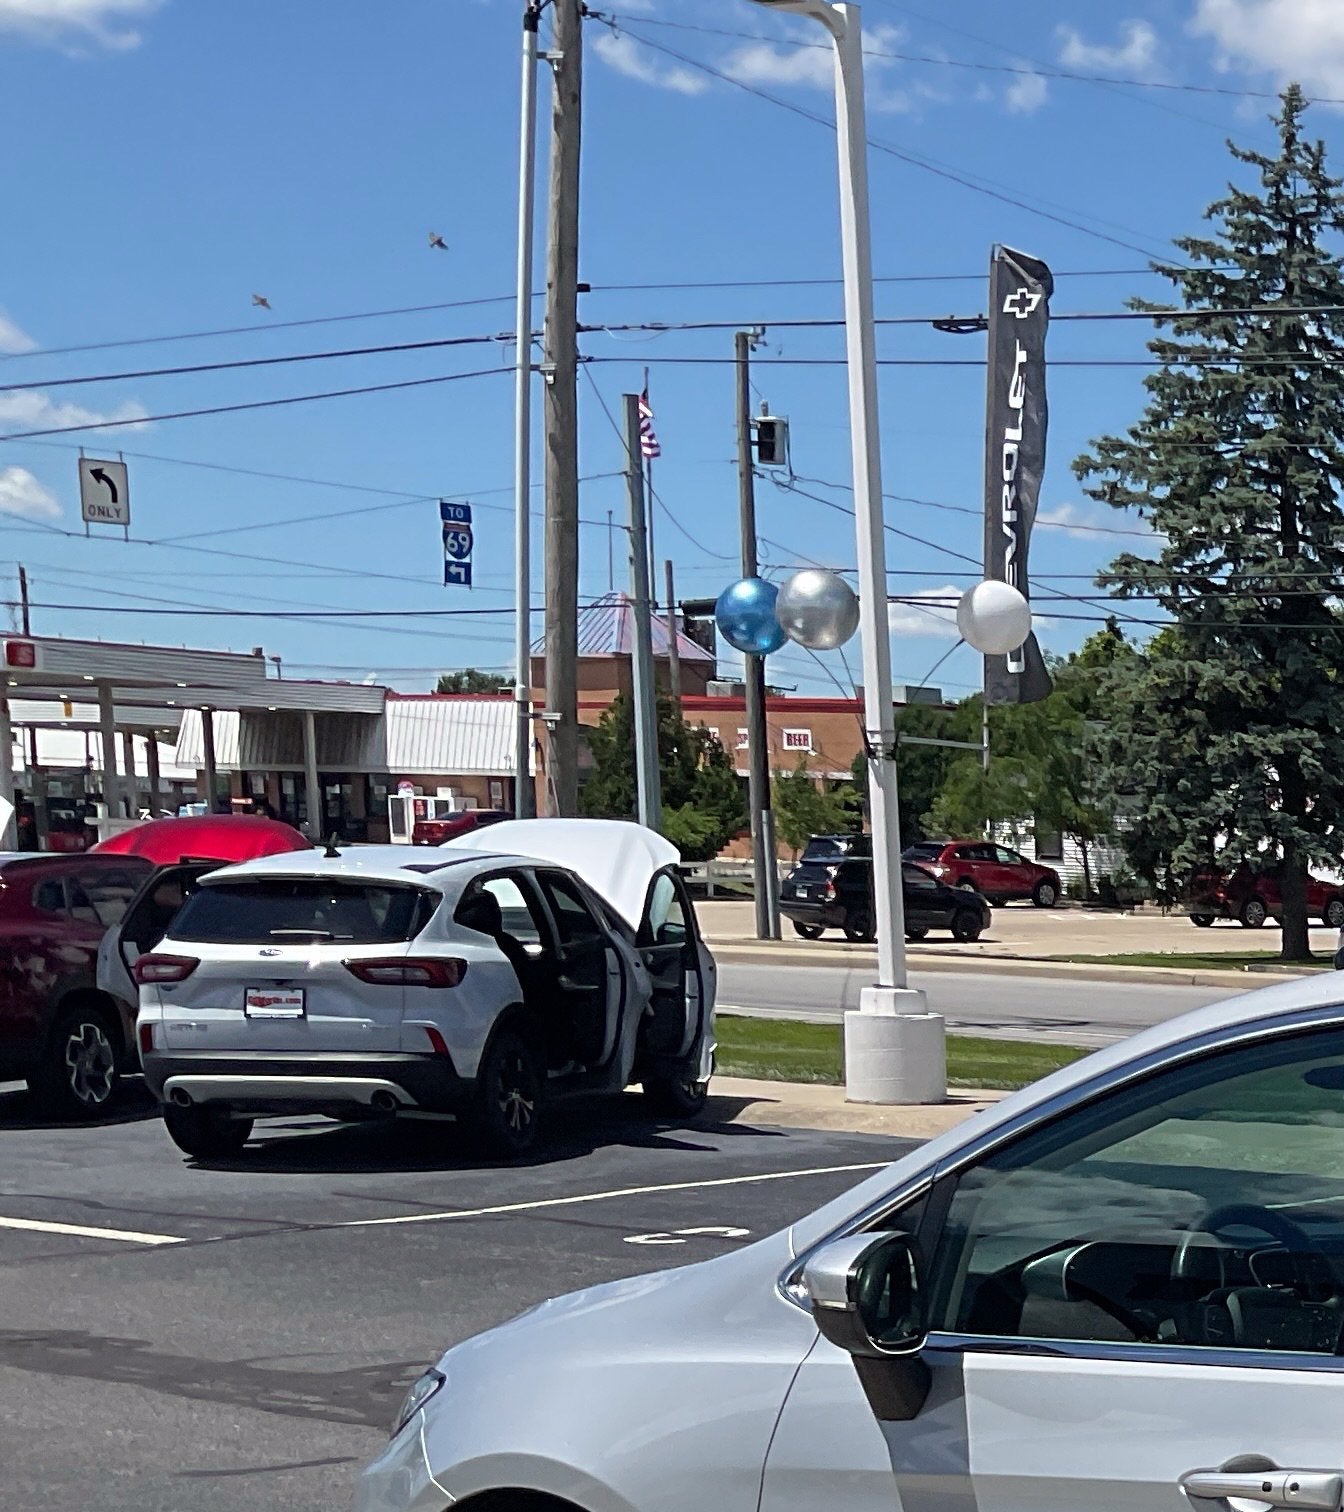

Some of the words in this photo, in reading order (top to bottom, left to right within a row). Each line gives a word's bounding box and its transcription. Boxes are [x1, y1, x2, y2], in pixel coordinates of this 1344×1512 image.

[88, 504, 121, 519] ONLY
[447, 506, 464, 519] TO
[1002, 338, 1028, 674] CEVROLET
[446, 532, 471, 553] 69
